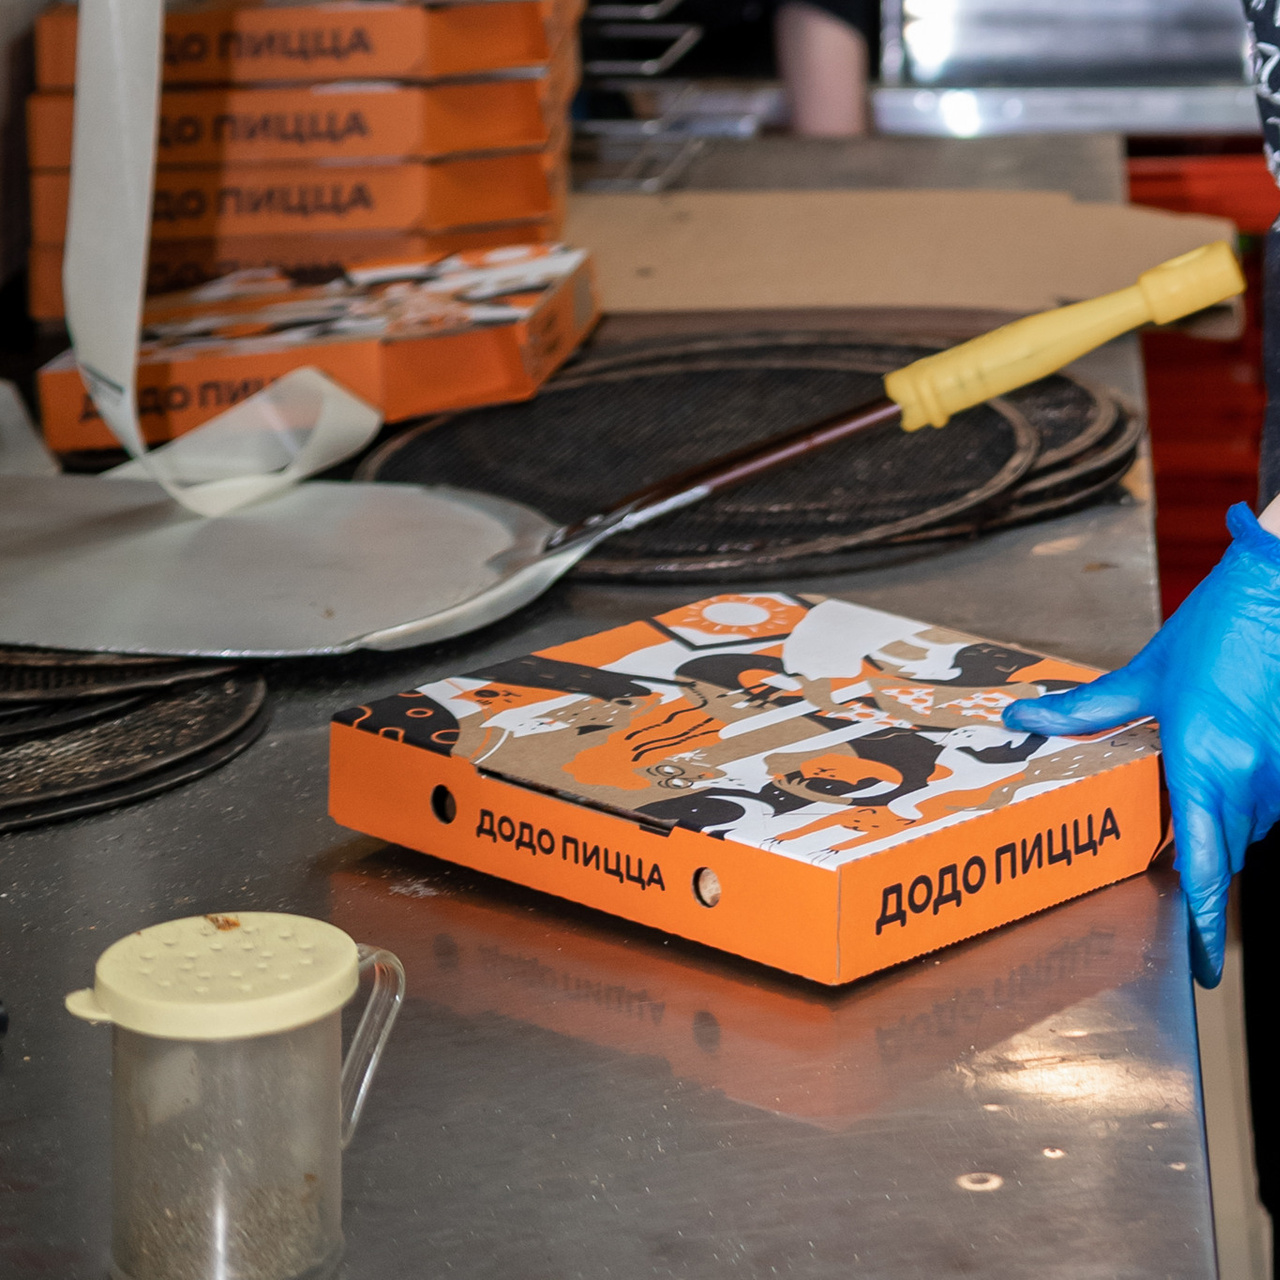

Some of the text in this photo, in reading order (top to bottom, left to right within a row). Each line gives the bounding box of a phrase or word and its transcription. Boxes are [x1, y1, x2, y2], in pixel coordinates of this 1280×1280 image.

[216, 26, 372, 62] ПИЦЦА
[213, 111, 370, 147] ПИЦЦА
[218, 184, 373, 218] ПИЦЦА
[476, 808, 665, 891] ДОДО ПИЦЦА
[875, 807, 1121, 936] ДОДО ПИЦЦА
